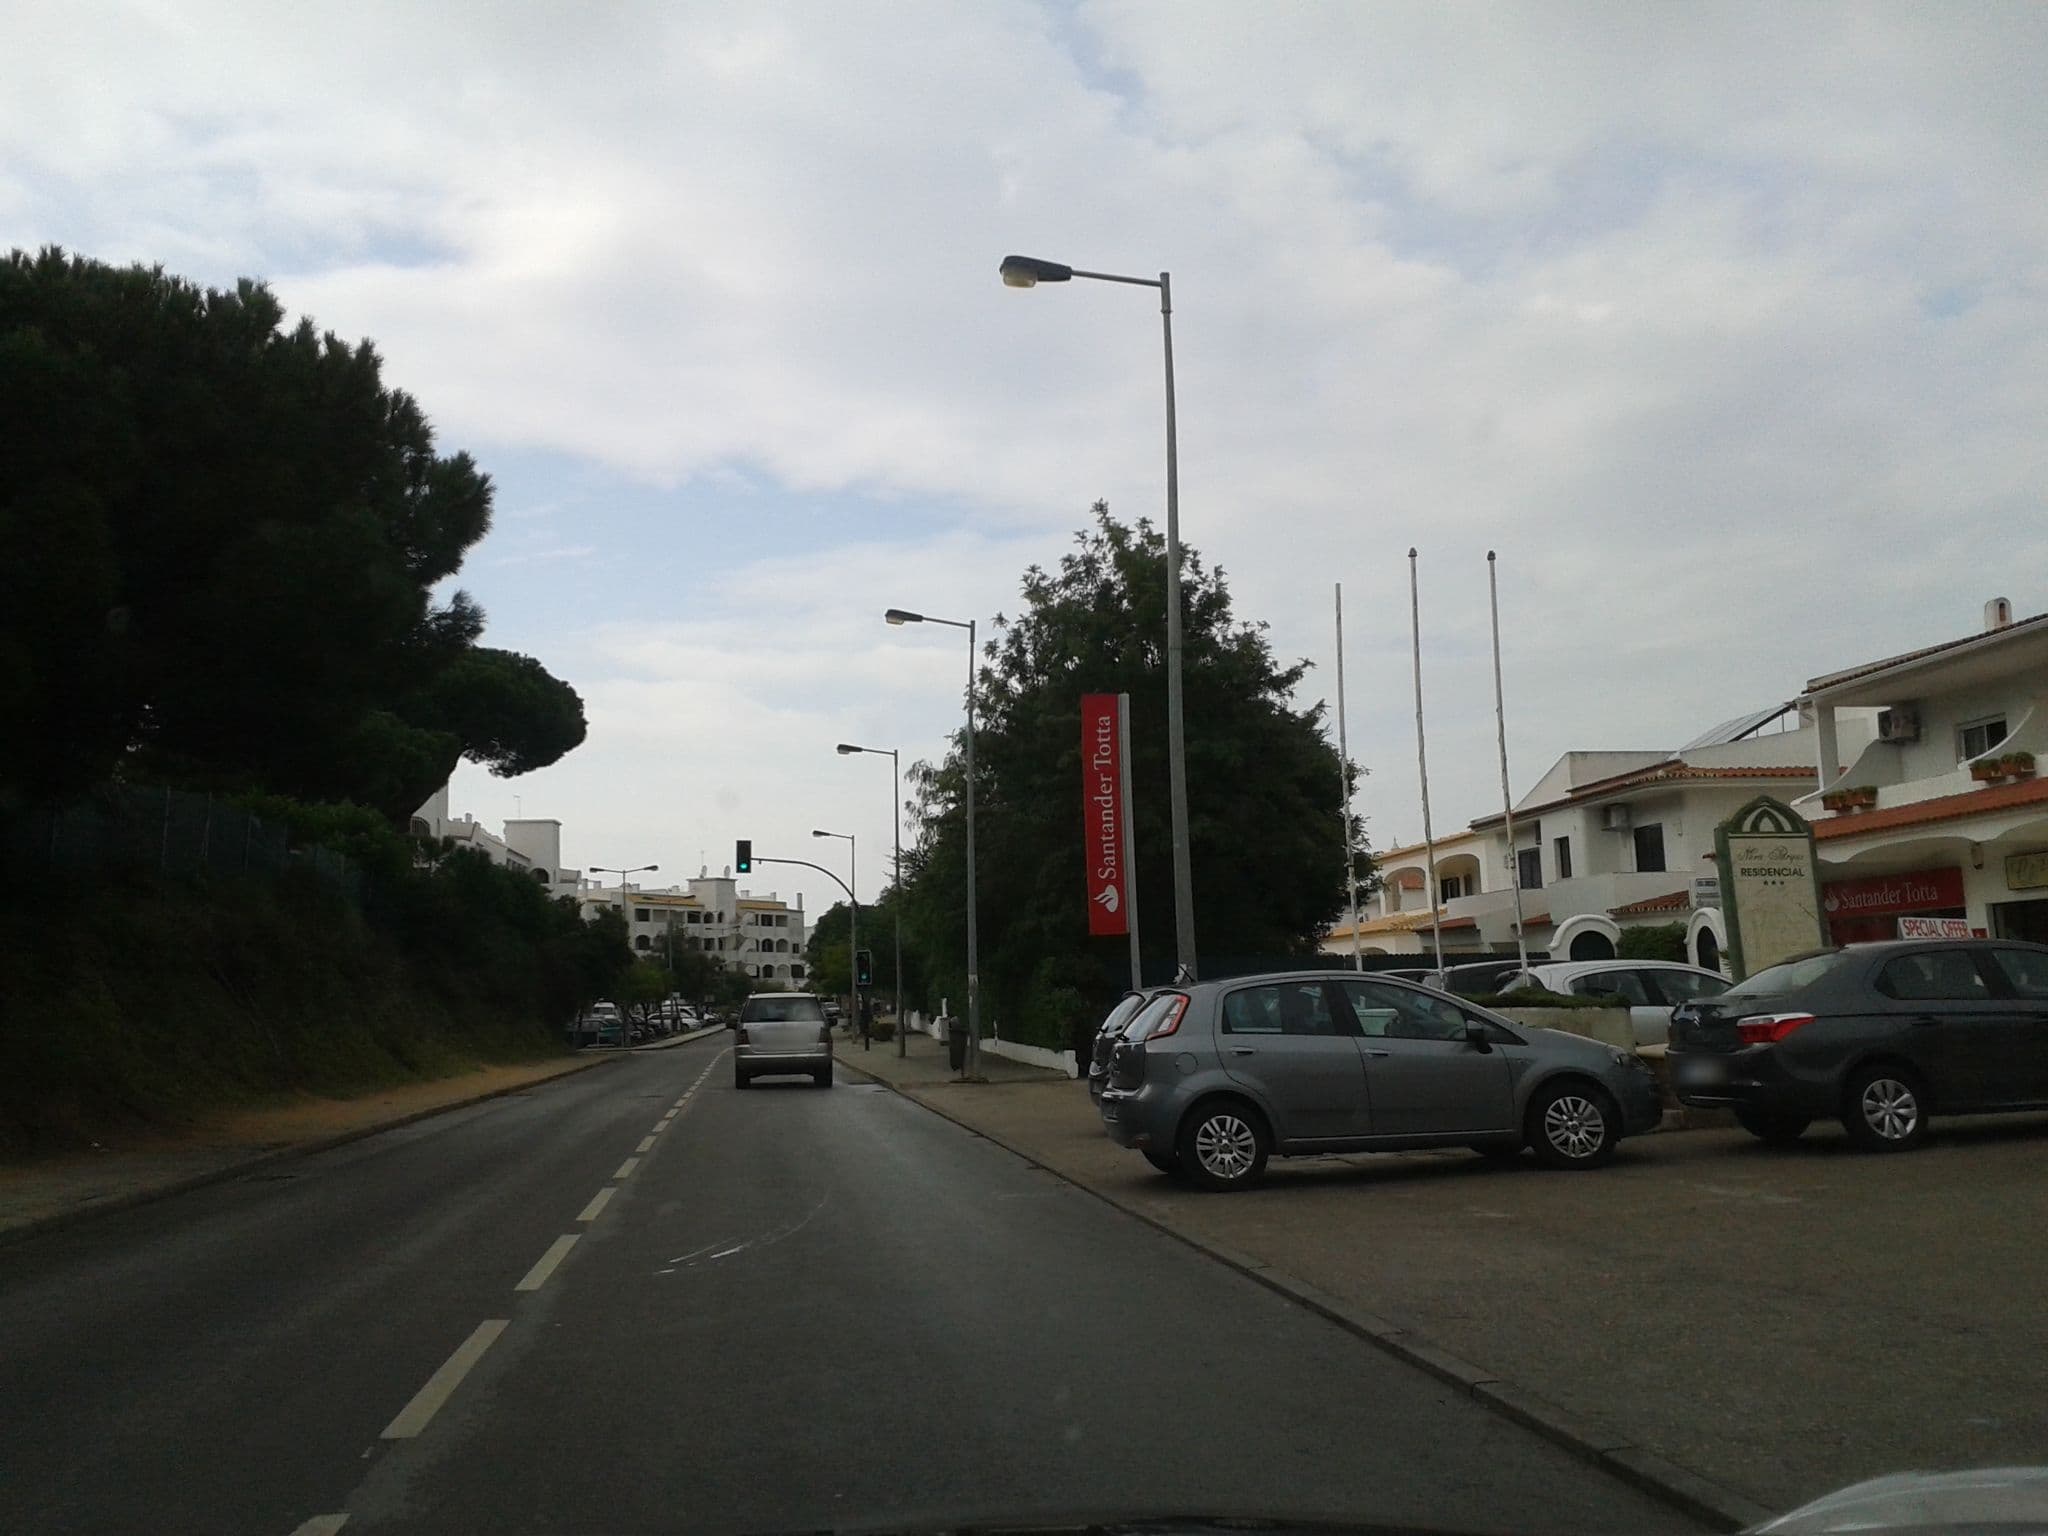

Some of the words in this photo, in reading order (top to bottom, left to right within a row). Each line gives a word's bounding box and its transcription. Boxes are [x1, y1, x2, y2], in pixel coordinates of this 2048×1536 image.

[1093, 715, 1113, 771] Totta
[1093, 773, 1117, 880] Santander
[1740, 867, 1805, 877] RESIDENCIAL
[1841, 883, 1901, 909] Santander
[1904, 881, 1938, 904] Totta
[1902, 919, 1941, 938] SPECIAL
[1941, 920, 1970, 939] OFFER
